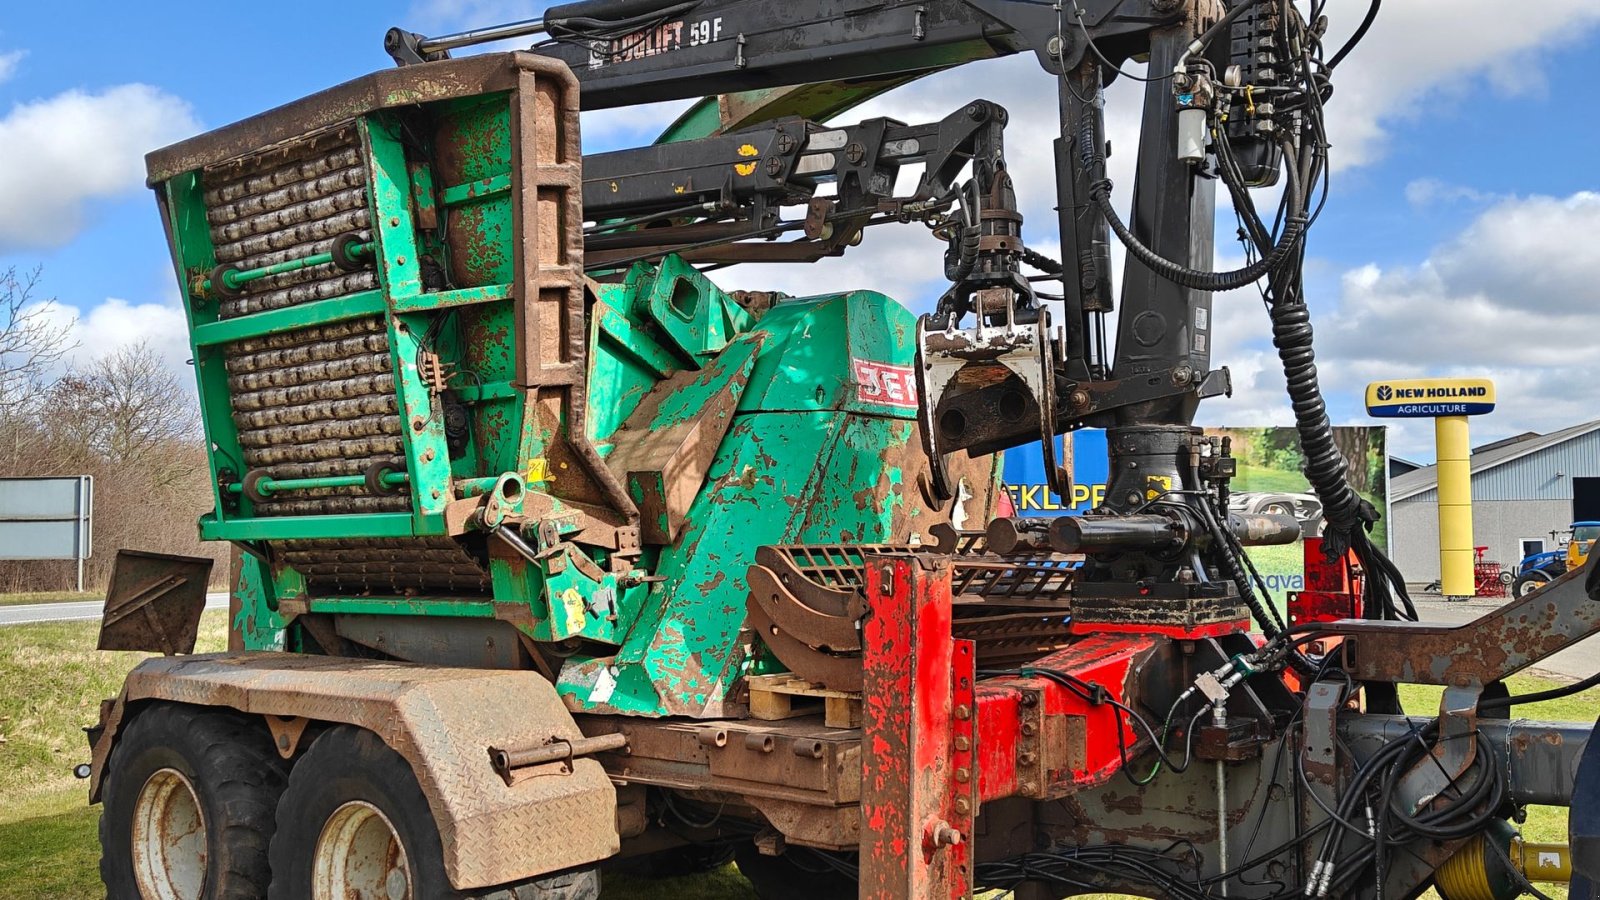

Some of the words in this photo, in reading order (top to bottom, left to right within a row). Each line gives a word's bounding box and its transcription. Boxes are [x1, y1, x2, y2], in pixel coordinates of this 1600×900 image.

[690, 20, 710, 47] 59
[713, 17, 722, 42] F
[1396, 389, 1424, 398] NEW
[1427, 387, 1487, 398] HOLLAND
[1397, 404, 1467, 414] AGRICULTURE
